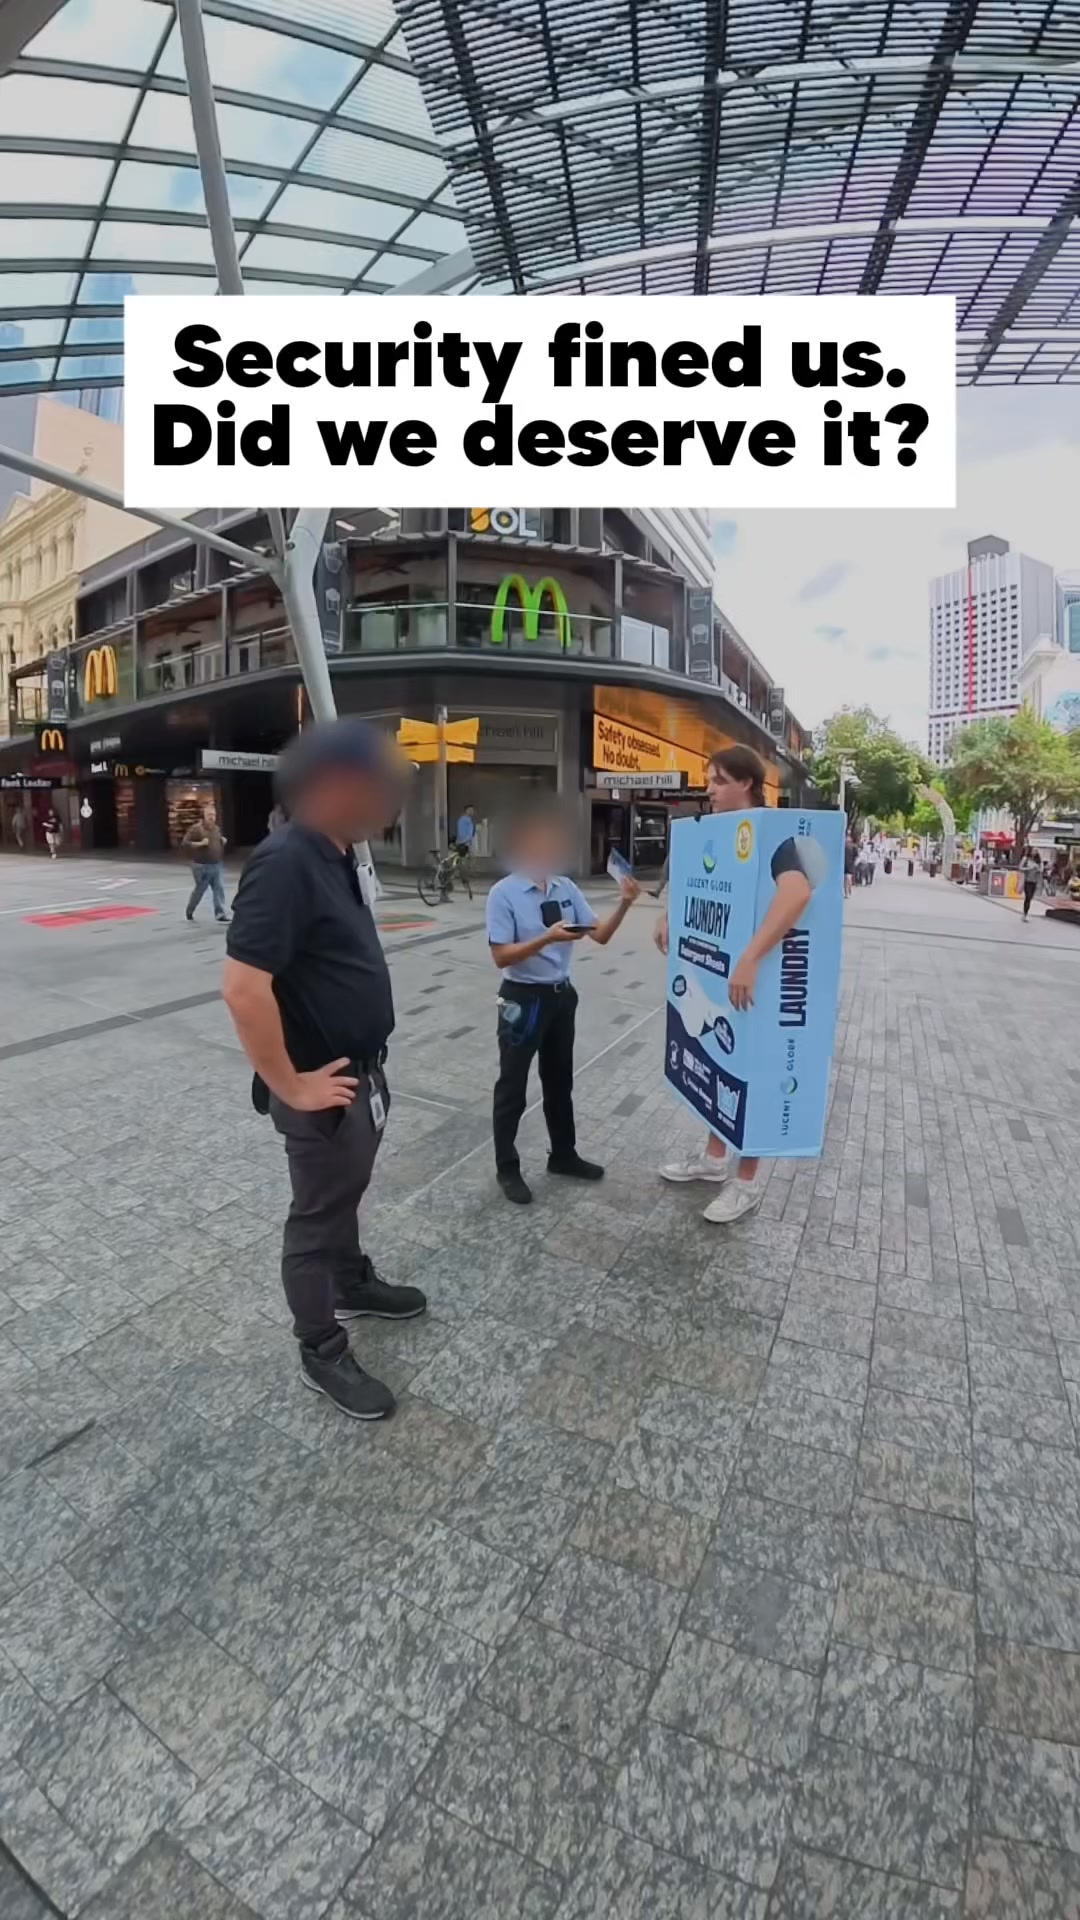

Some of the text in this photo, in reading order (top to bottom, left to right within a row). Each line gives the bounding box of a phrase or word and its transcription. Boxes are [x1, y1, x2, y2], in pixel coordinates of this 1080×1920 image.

[598, 720, 626, 751] Safety
[219, 756, 261, 767] michael
[603, 744, 640, 771] No doubt.
[603, 775, 673, 785] michael hill
[687, 878, 732, 893] LUCENT GLOBE
[685, 896, 731, 940] LAUNDRY
[779, 928, 809, 1027] LAUNDRY
[781, 1038, 796, 1136] LUCENT GLOBE
